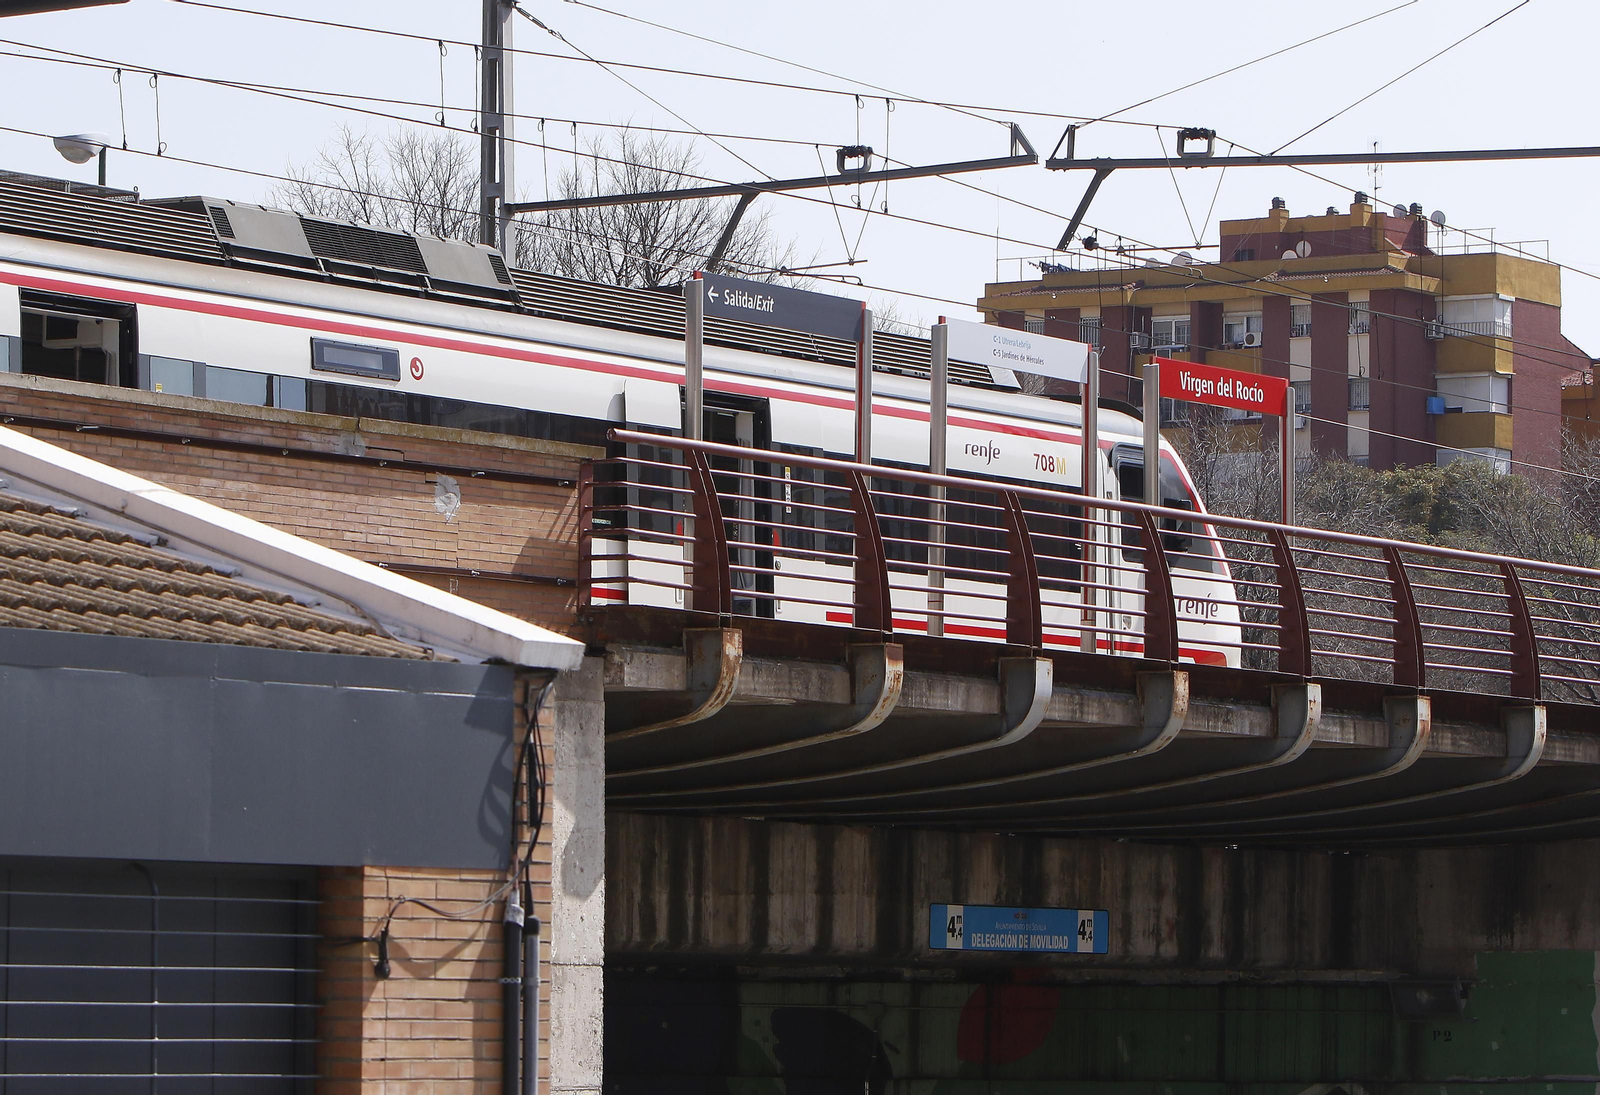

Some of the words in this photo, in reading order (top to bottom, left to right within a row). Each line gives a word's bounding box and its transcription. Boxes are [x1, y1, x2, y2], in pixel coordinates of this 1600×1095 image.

[724, 289, 775, 313] Salida/Exit
[993, 348, 1001, 357] C-5
[1020, 354, 1026, 362] de
[1179, 371, 1214, 397] Virgen
[1217, 376, 1233, 398] del
[1236, 381, 1264, 403] Rocío
[965, 440, 1000, 465] renfe
[1178, 593, 1218, 625] renfe
[971, 931, 1017, 948] DELEGACIÓN
[1019, 935, 1028, 948] DE
[1030, 934, 1069, 949] MOVILIDAD
